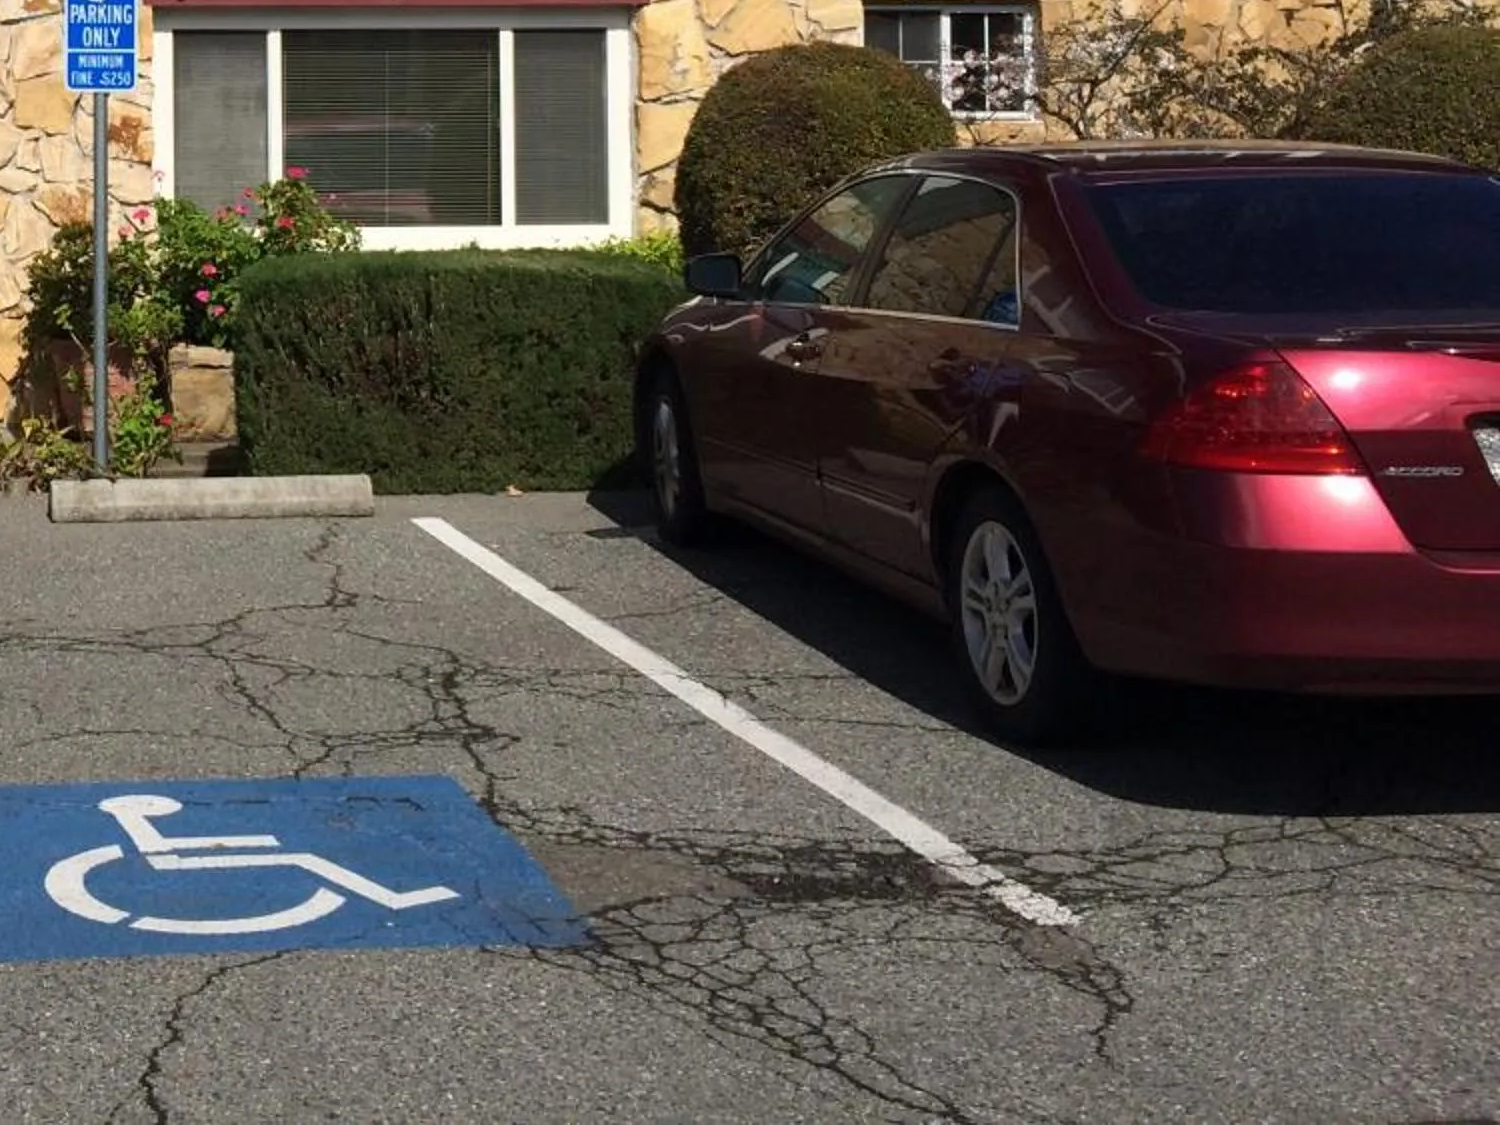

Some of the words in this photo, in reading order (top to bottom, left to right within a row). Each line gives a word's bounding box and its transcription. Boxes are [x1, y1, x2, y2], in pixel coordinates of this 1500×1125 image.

[69, 4, 132, 24] PARKING
[82, 27, 121, 46] ONLY
[78, 55, 124, 69] MINIMUM
[71, 71, 94, 86] FINE
[100, 71, 131, 86] $250
